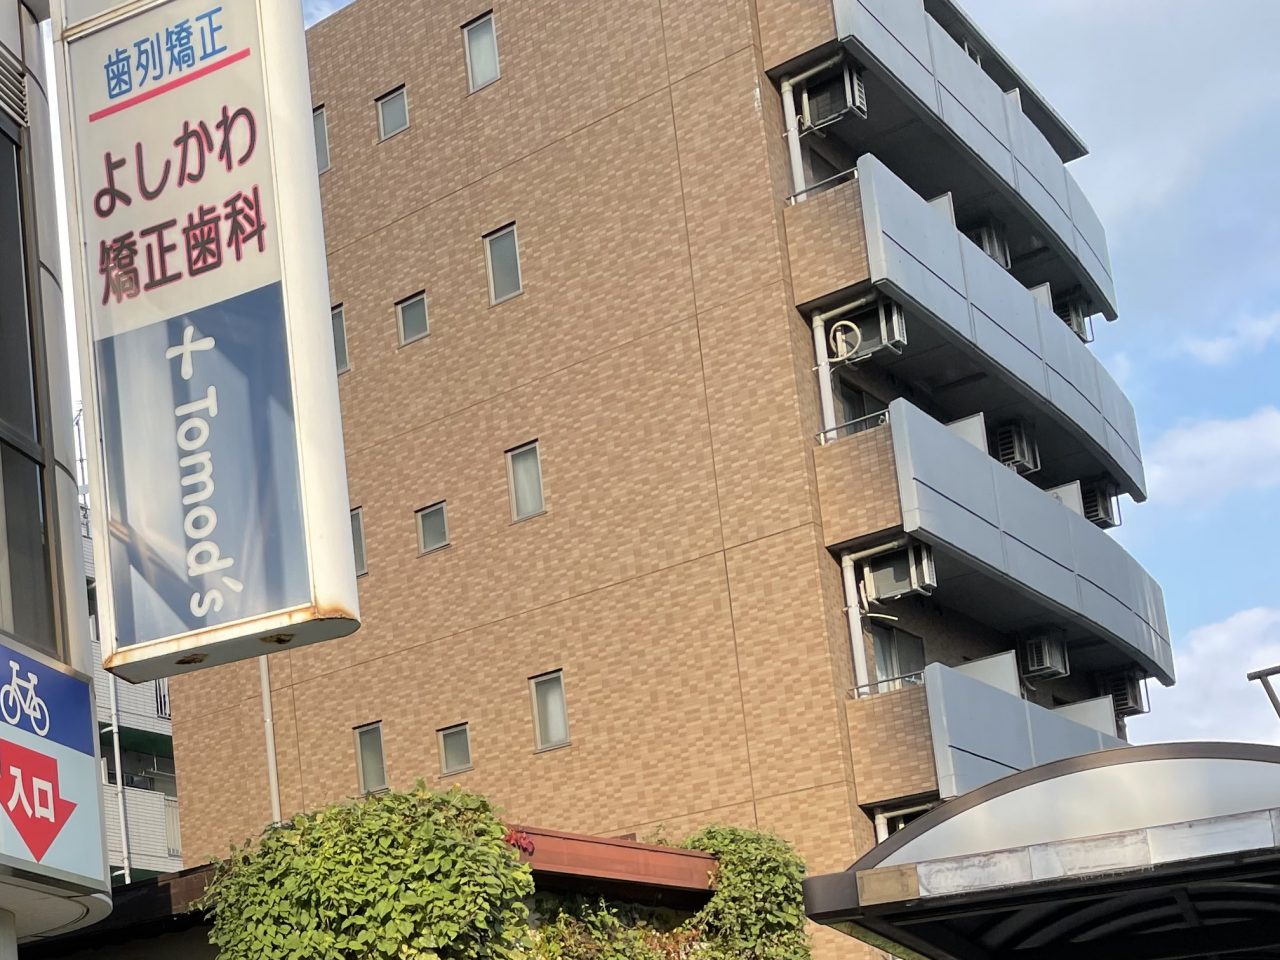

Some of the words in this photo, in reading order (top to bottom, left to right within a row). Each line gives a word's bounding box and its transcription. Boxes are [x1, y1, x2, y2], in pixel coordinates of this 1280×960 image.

[103, 7, 227, 100] 歯列矯正
[94, 105, 257, 218] よしかわ
[98, 184, 267, 305] 矯正歯科
[174, 385, 244, 618] Tomod's
[7, 765, 56, 823] 入口
